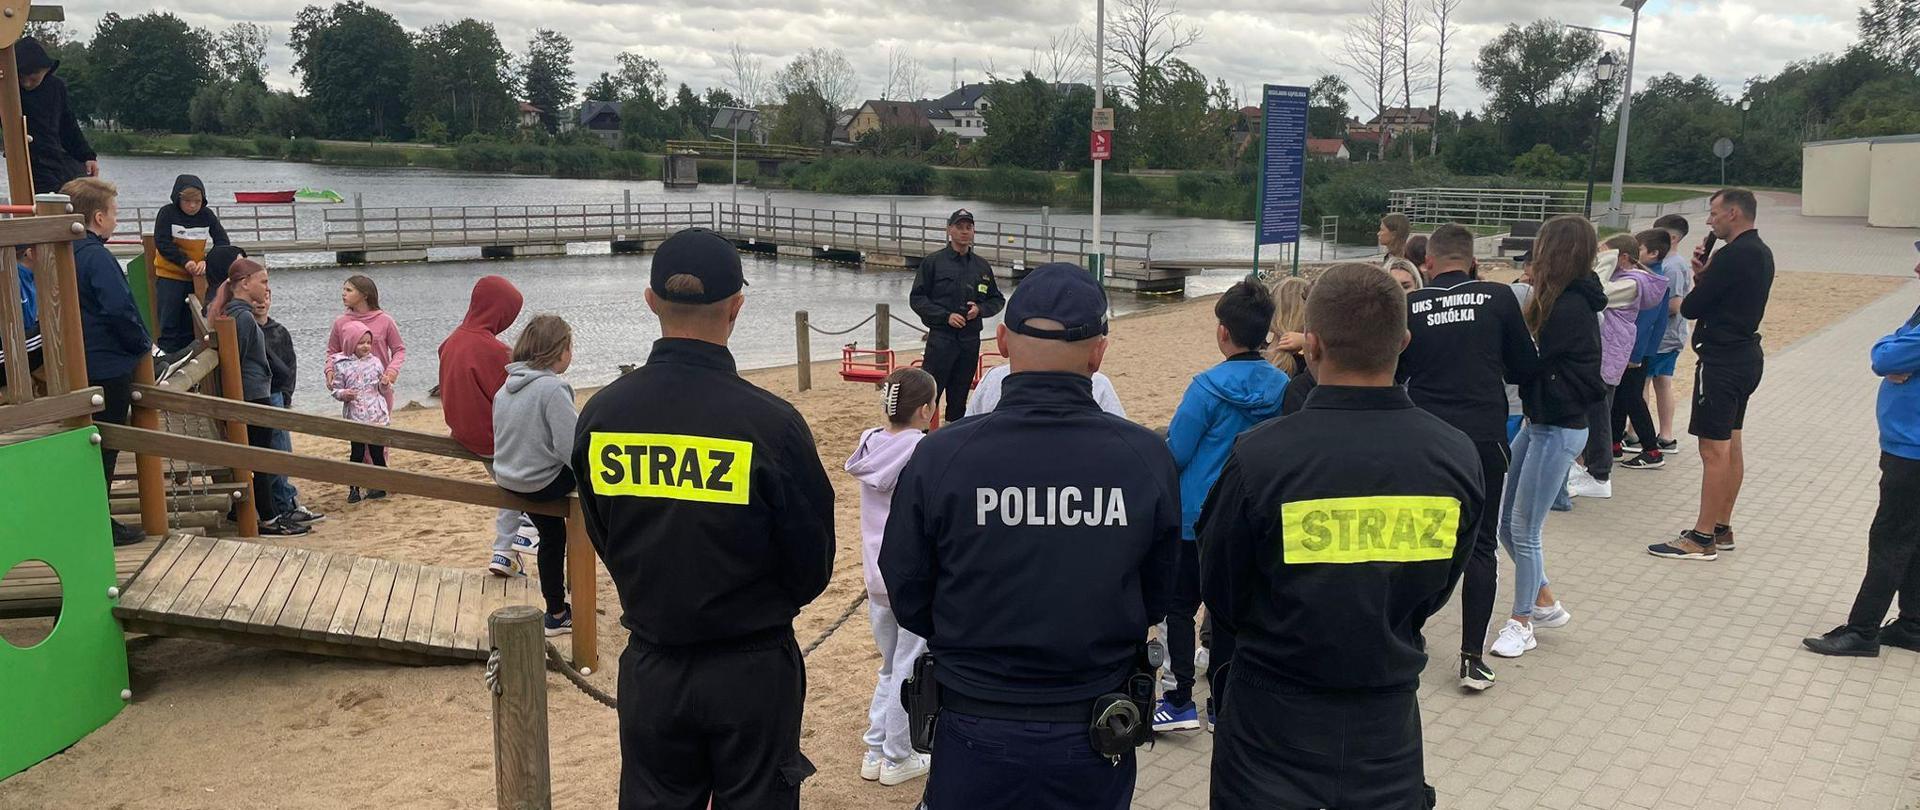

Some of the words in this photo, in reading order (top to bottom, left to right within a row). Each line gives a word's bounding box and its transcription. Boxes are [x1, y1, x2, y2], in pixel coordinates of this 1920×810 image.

[1412, 299, 1433, 314] UKS
[1427, 308, 1475, 326] SOKÓŁKA
[976, 486, 1128, 526] POLICJA
